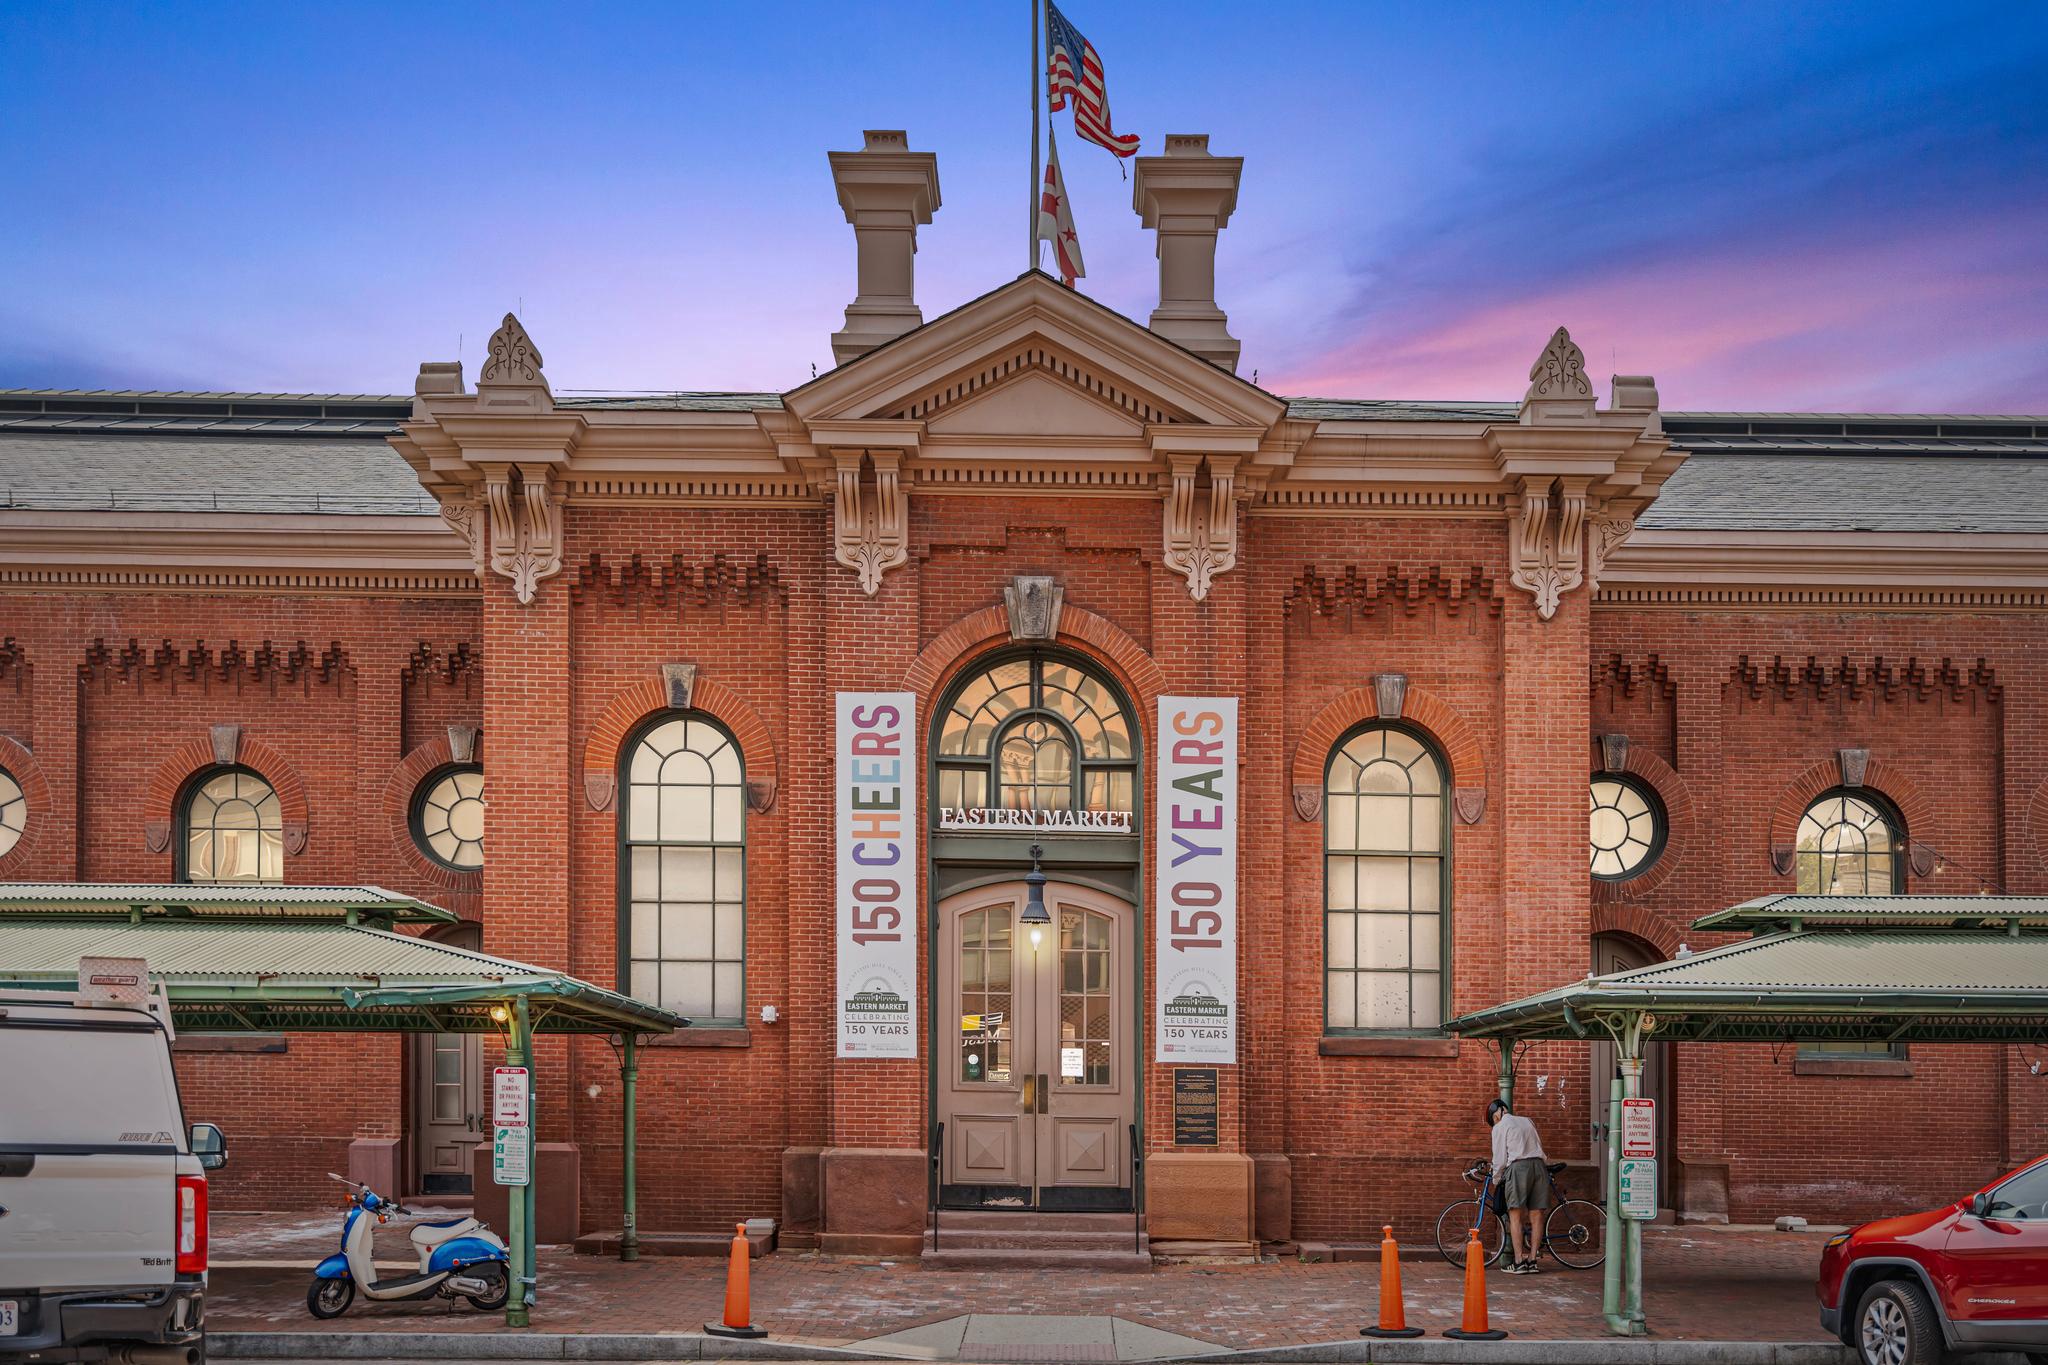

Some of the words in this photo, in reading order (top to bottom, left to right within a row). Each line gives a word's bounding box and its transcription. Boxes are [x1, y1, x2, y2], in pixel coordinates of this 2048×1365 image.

[852, 705, 900, 866] CHEERS
[1171, 711, 1223, 868] YEARS
[940, 807, 1035, 825] EASTERN
[1042, 809, 1133, 828] MARKET
[852, 879, 901, 946] 150
[1171, 882, 1223, 953] 150
[1166, 1006, 1197, 1014] EASTERN
[1198, 1007, 1226, 1015] MARKET
[845, 1013, 910, 1021] CELEBRATING
[1164, 1017, 1229, 1025] CELEBRATING
[845, 1025, 866, 1034] 150
[872, 1025, 909, 1035] YEARS
[1164, 1029, 1185, 1038] 150
[1191, 1029, 1228, 1039] YEARS
[140, 1257, 155, 1266] Ted
[156, 1257, 173, 1266] Britt
